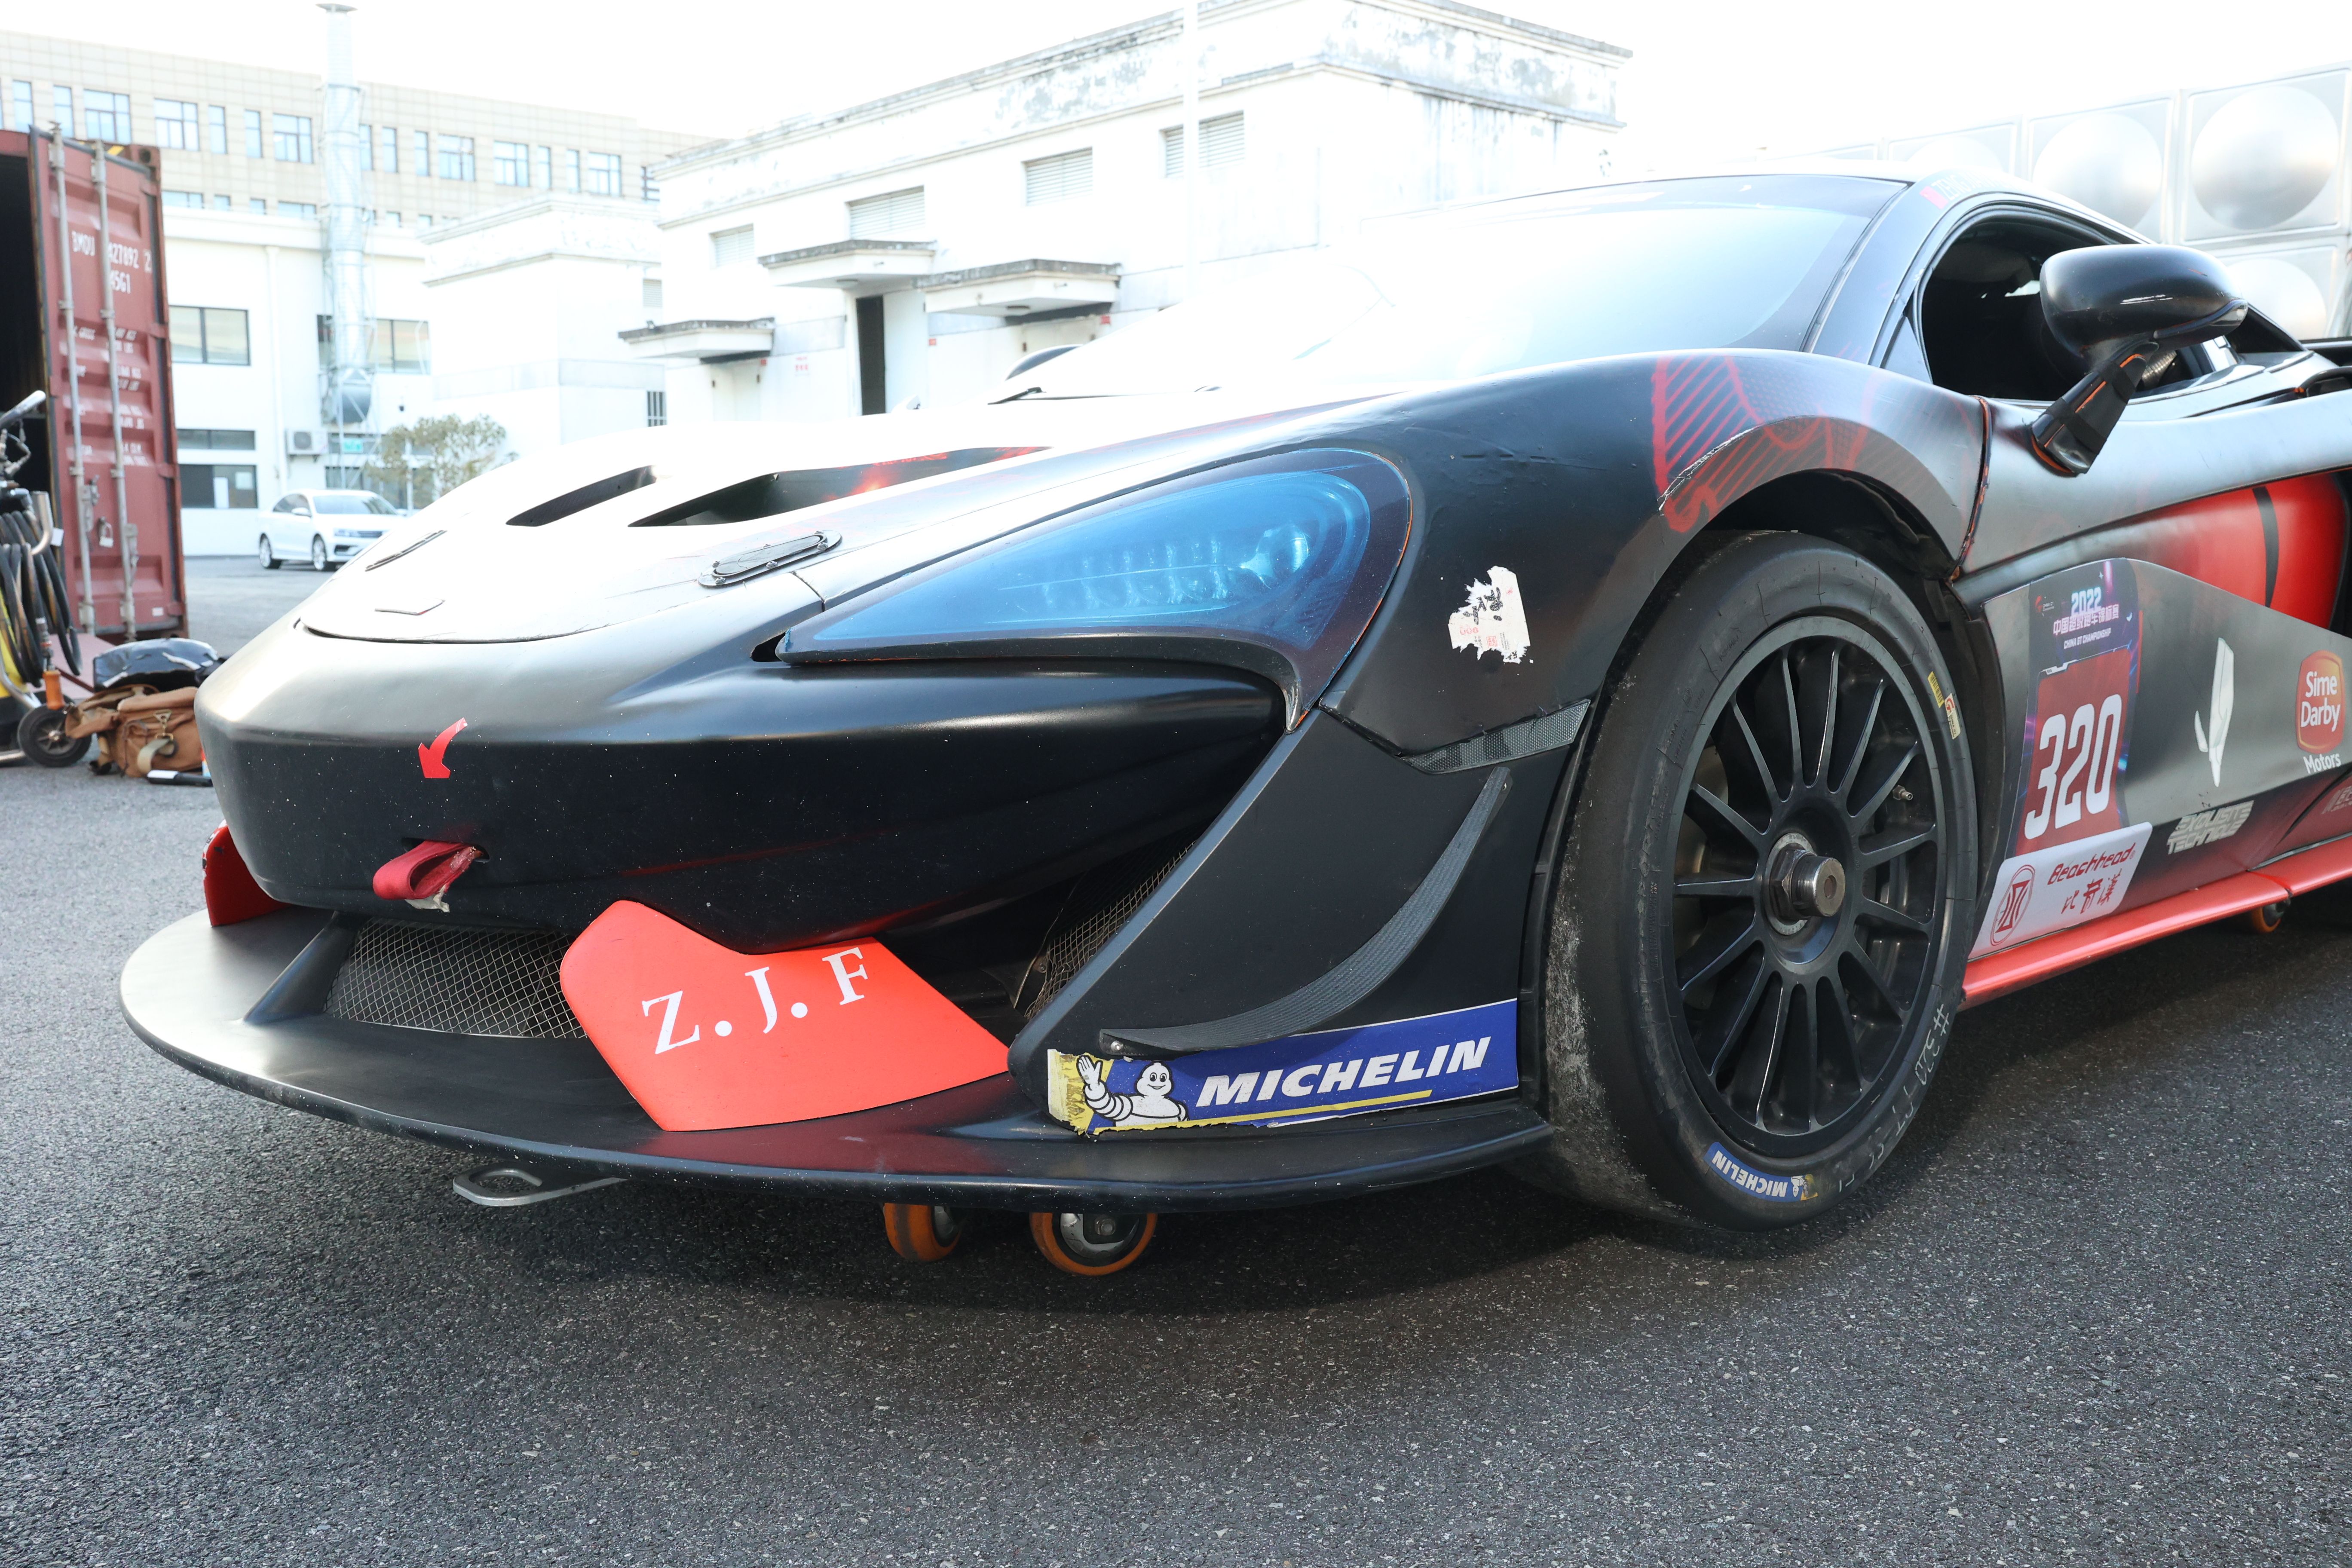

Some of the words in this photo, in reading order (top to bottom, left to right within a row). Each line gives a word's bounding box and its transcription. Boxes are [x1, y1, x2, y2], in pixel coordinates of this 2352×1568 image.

[2071, 586, 2101, 616] 2022
[2064, 637, 2076, 649] CHINA
[2077, 636, 2082, 646] GT
[2082, 628, 2112, 644] CHAMPIONSHIP
[2305, 671, 2337, 698] Sime
[2300, 698, 2341, 732] Darby
[2024, 694, 2122, 839] 320
[2303, 753, 2341, 774] Motors
[2047, 842, 2136, 885] Beachhead
[1195, 1035, 1491, 1108] MICHELIN
[1712, 1150, 1788, 1197] MICHELIN
